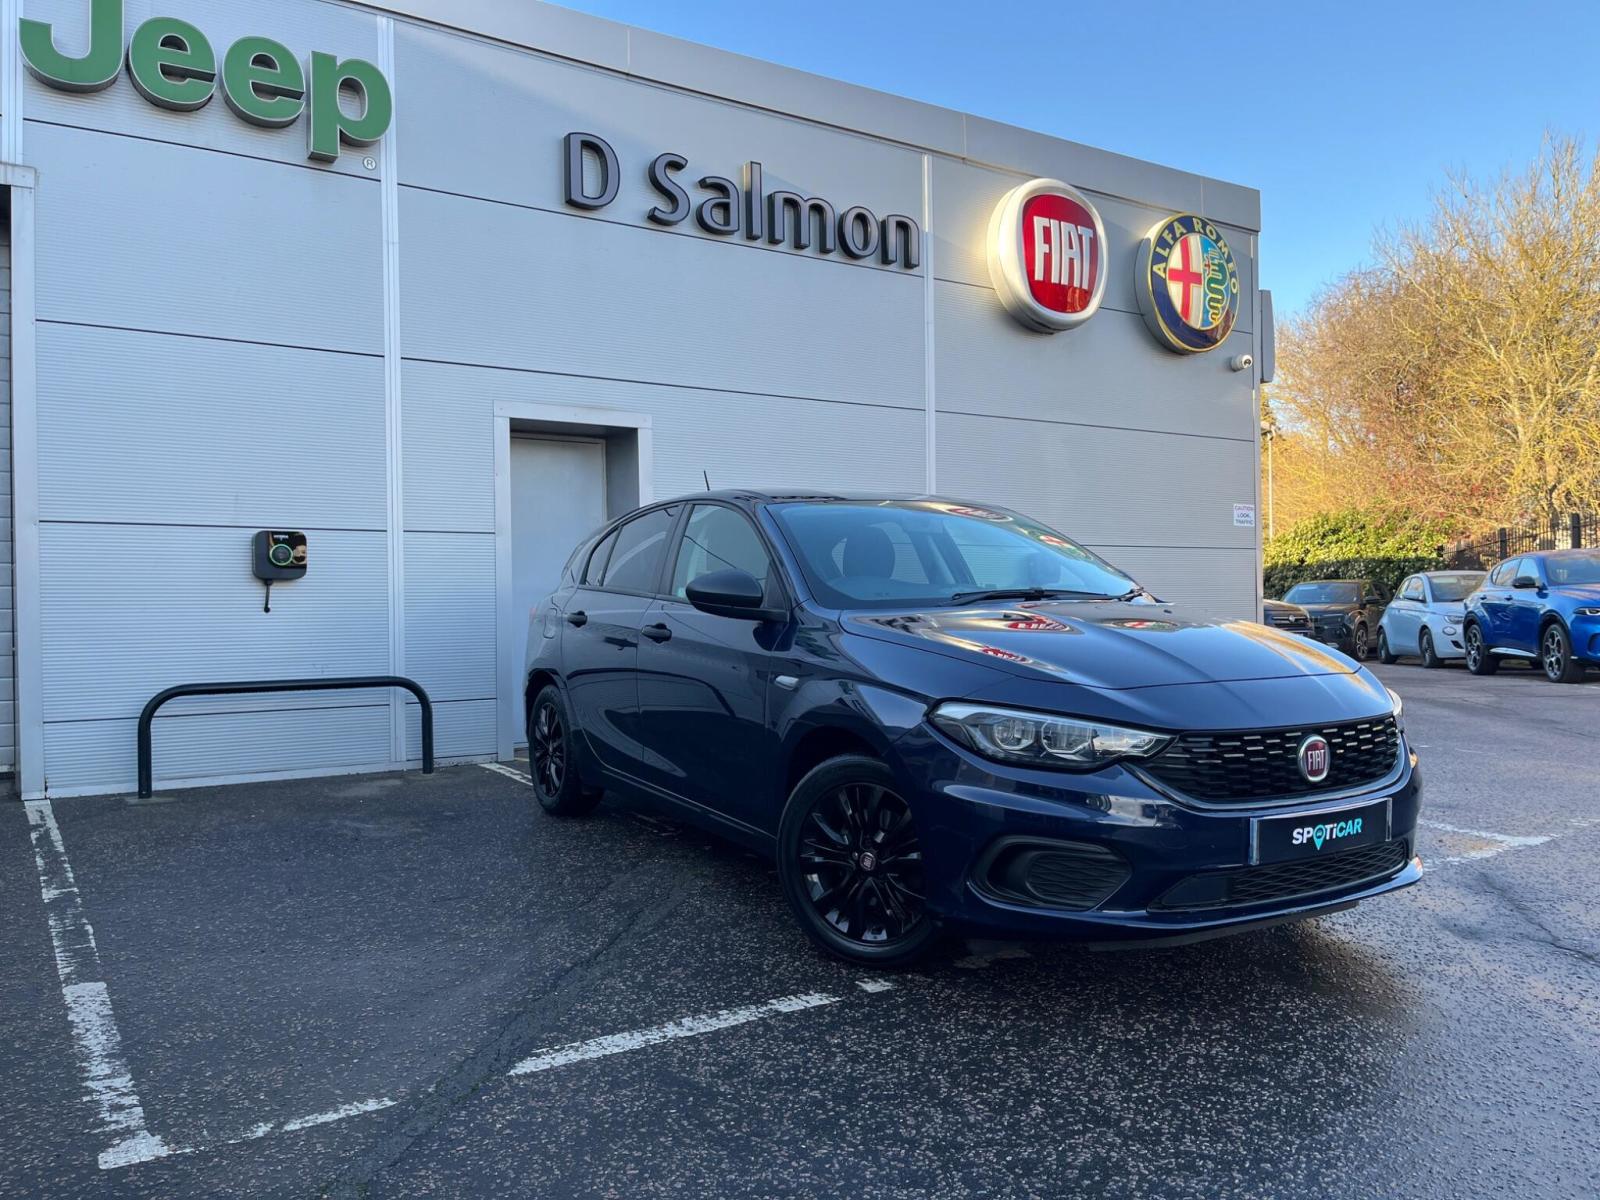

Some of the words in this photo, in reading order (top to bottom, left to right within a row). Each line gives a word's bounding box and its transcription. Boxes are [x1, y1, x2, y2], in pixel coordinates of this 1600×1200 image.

[19, 0, 392, 163] Jeep
[564, 132, 620, 210] D
[647, 152, 920, 269] Salmon
[1033, 215, 1093, 290] FIAT
[1152, 222, 1187, 280] ALFA
[1192, 217, 1238, 294] ROMEO
[1307, 749, 1325, 771] FIAT
